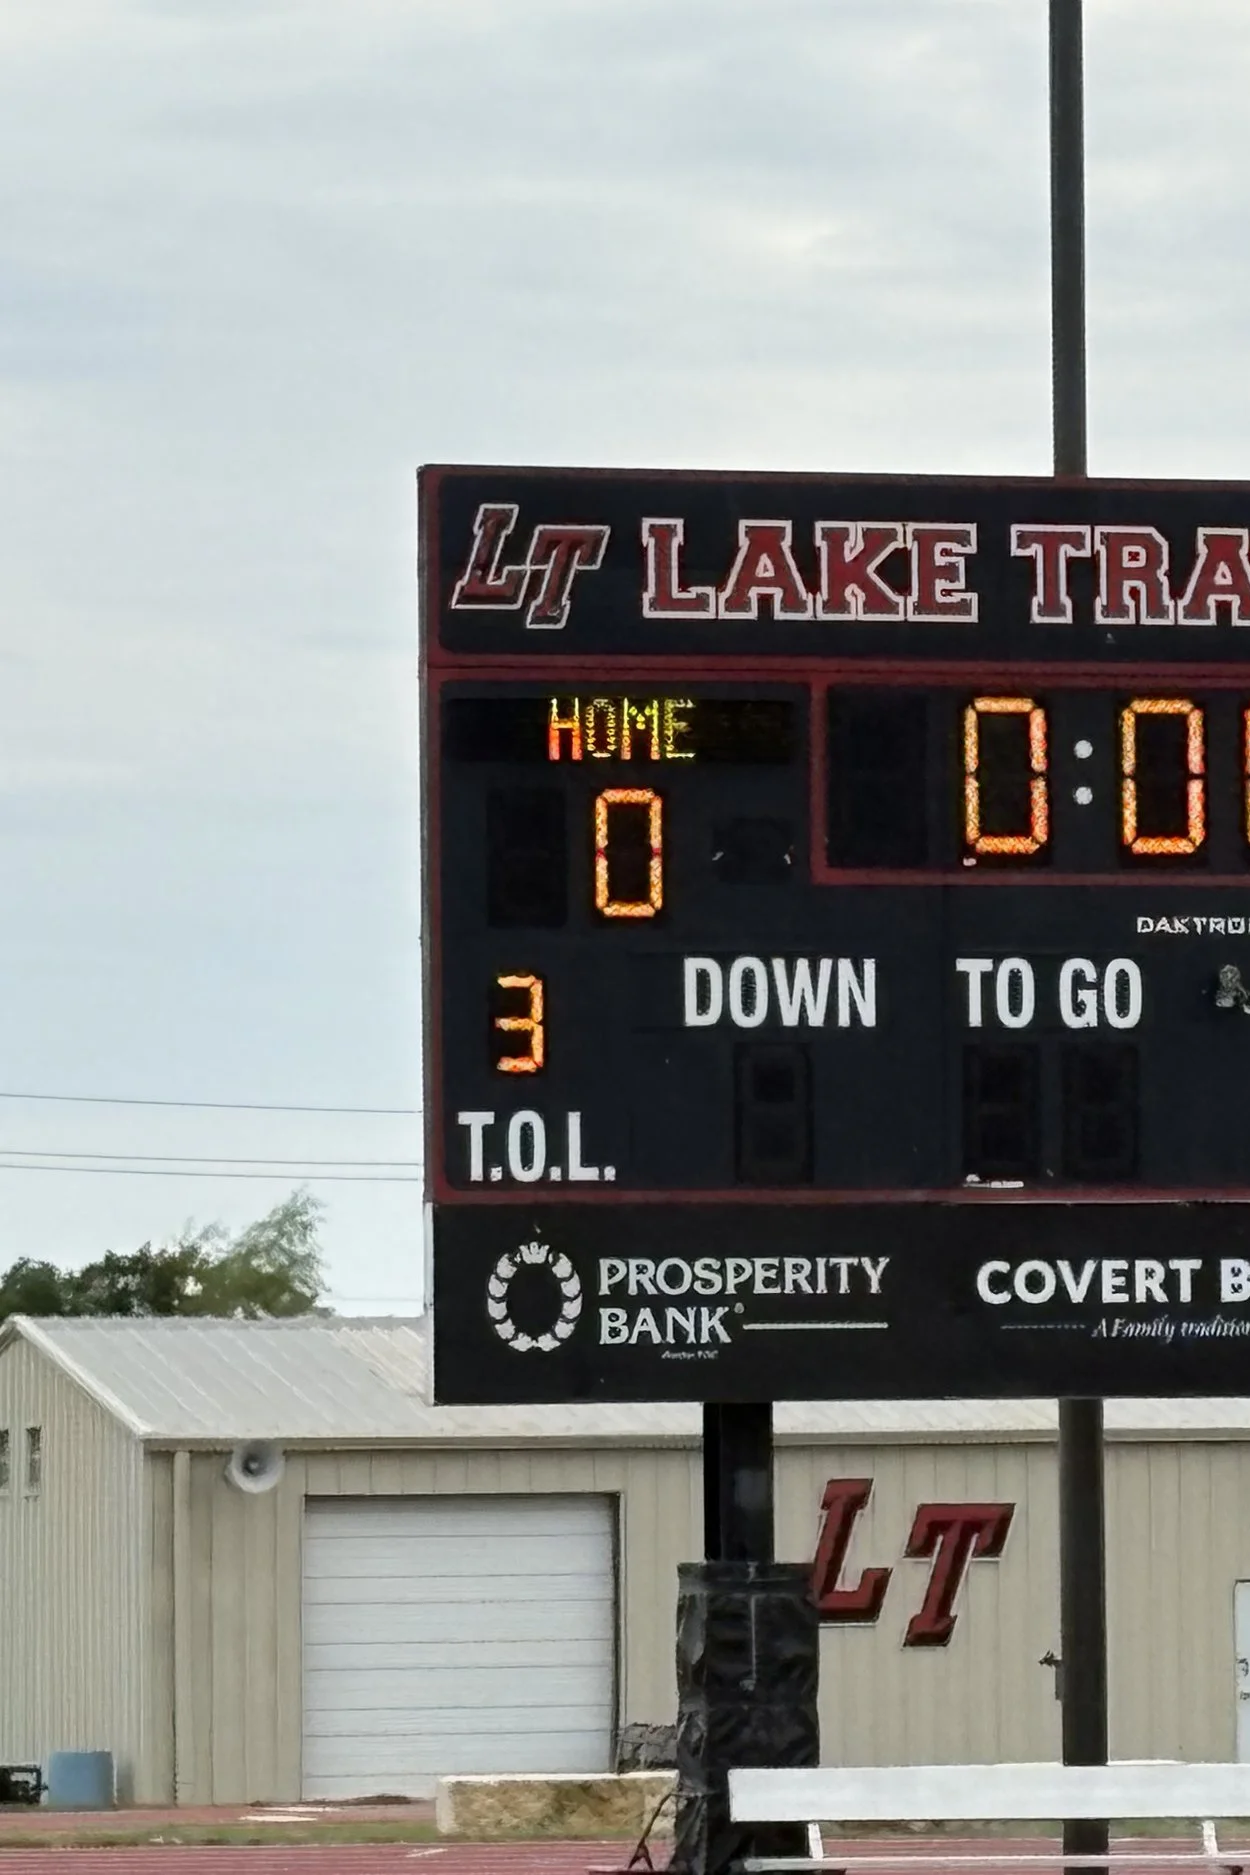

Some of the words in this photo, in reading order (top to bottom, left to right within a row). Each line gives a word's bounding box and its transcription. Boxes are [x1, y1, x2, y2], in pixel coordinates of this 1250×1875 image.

[451, 504, 610, 629] LT
[642, 518, 978, 623] LAKE
[549, 697, 695, 760] HOME
[595, 788, 662, 917] 0
[496, 975, 544, 1072] 3
[684, 957, 876, 1028] DOWN
[956, 958, 1034, 1028] TO
[1059, 958, 1142, 1028] GO
[458, 1110, 616, 1182] T.O.L.
[599, 1257, 889, 1295] PROSPERITY
[977, 1259, 1202, 1304] COVERT
[811, 1478, 1016, 1647] LT
